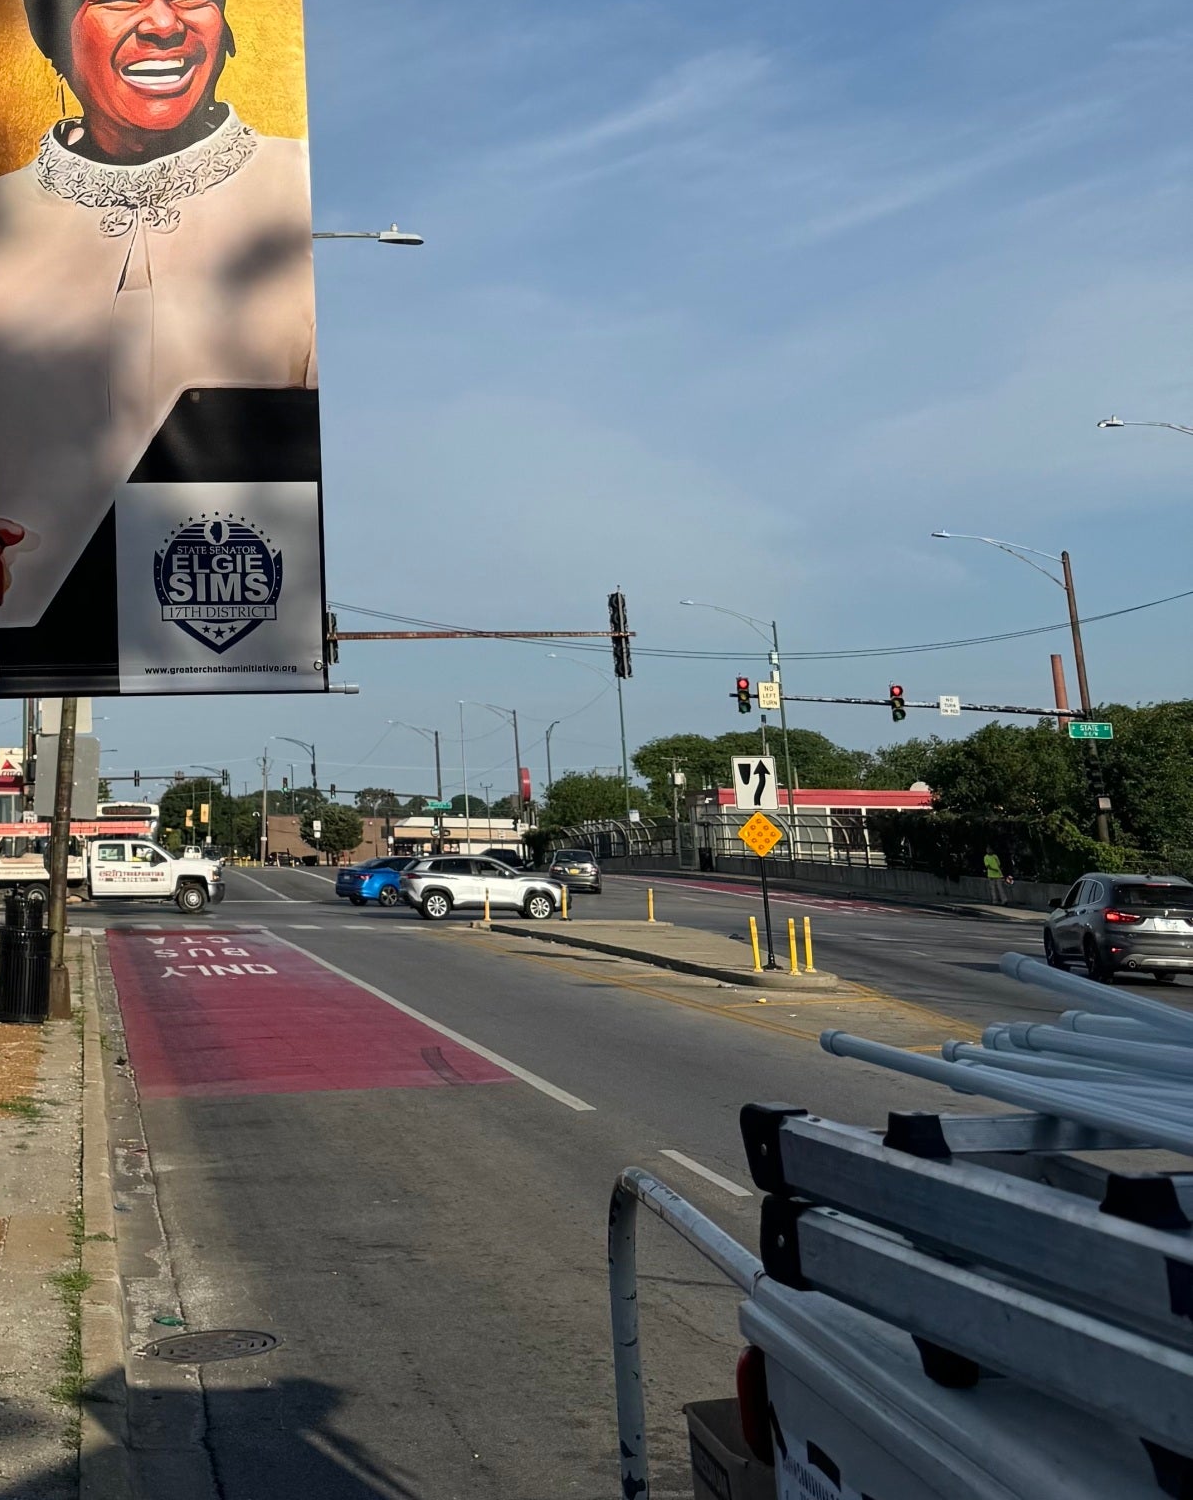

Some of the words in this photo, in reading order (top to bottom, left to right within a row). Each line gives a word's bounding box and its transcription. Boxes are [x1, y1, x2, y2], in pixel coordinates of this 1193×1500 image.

[177, 546, 206, 555] STATE
[210, 545, 257, 555] SENATOR
[172, 554, 264, 573] ELGIE
[168, 572, 270, 602] SIMS
[170, 606, 201, 618] 17TH
[206, 606, 270, 618] DISTRICT
[145, 936, 231, 945] CTA
[153, 947, 251, 958] BUS
[160, 963, 278, 978] ONLY
